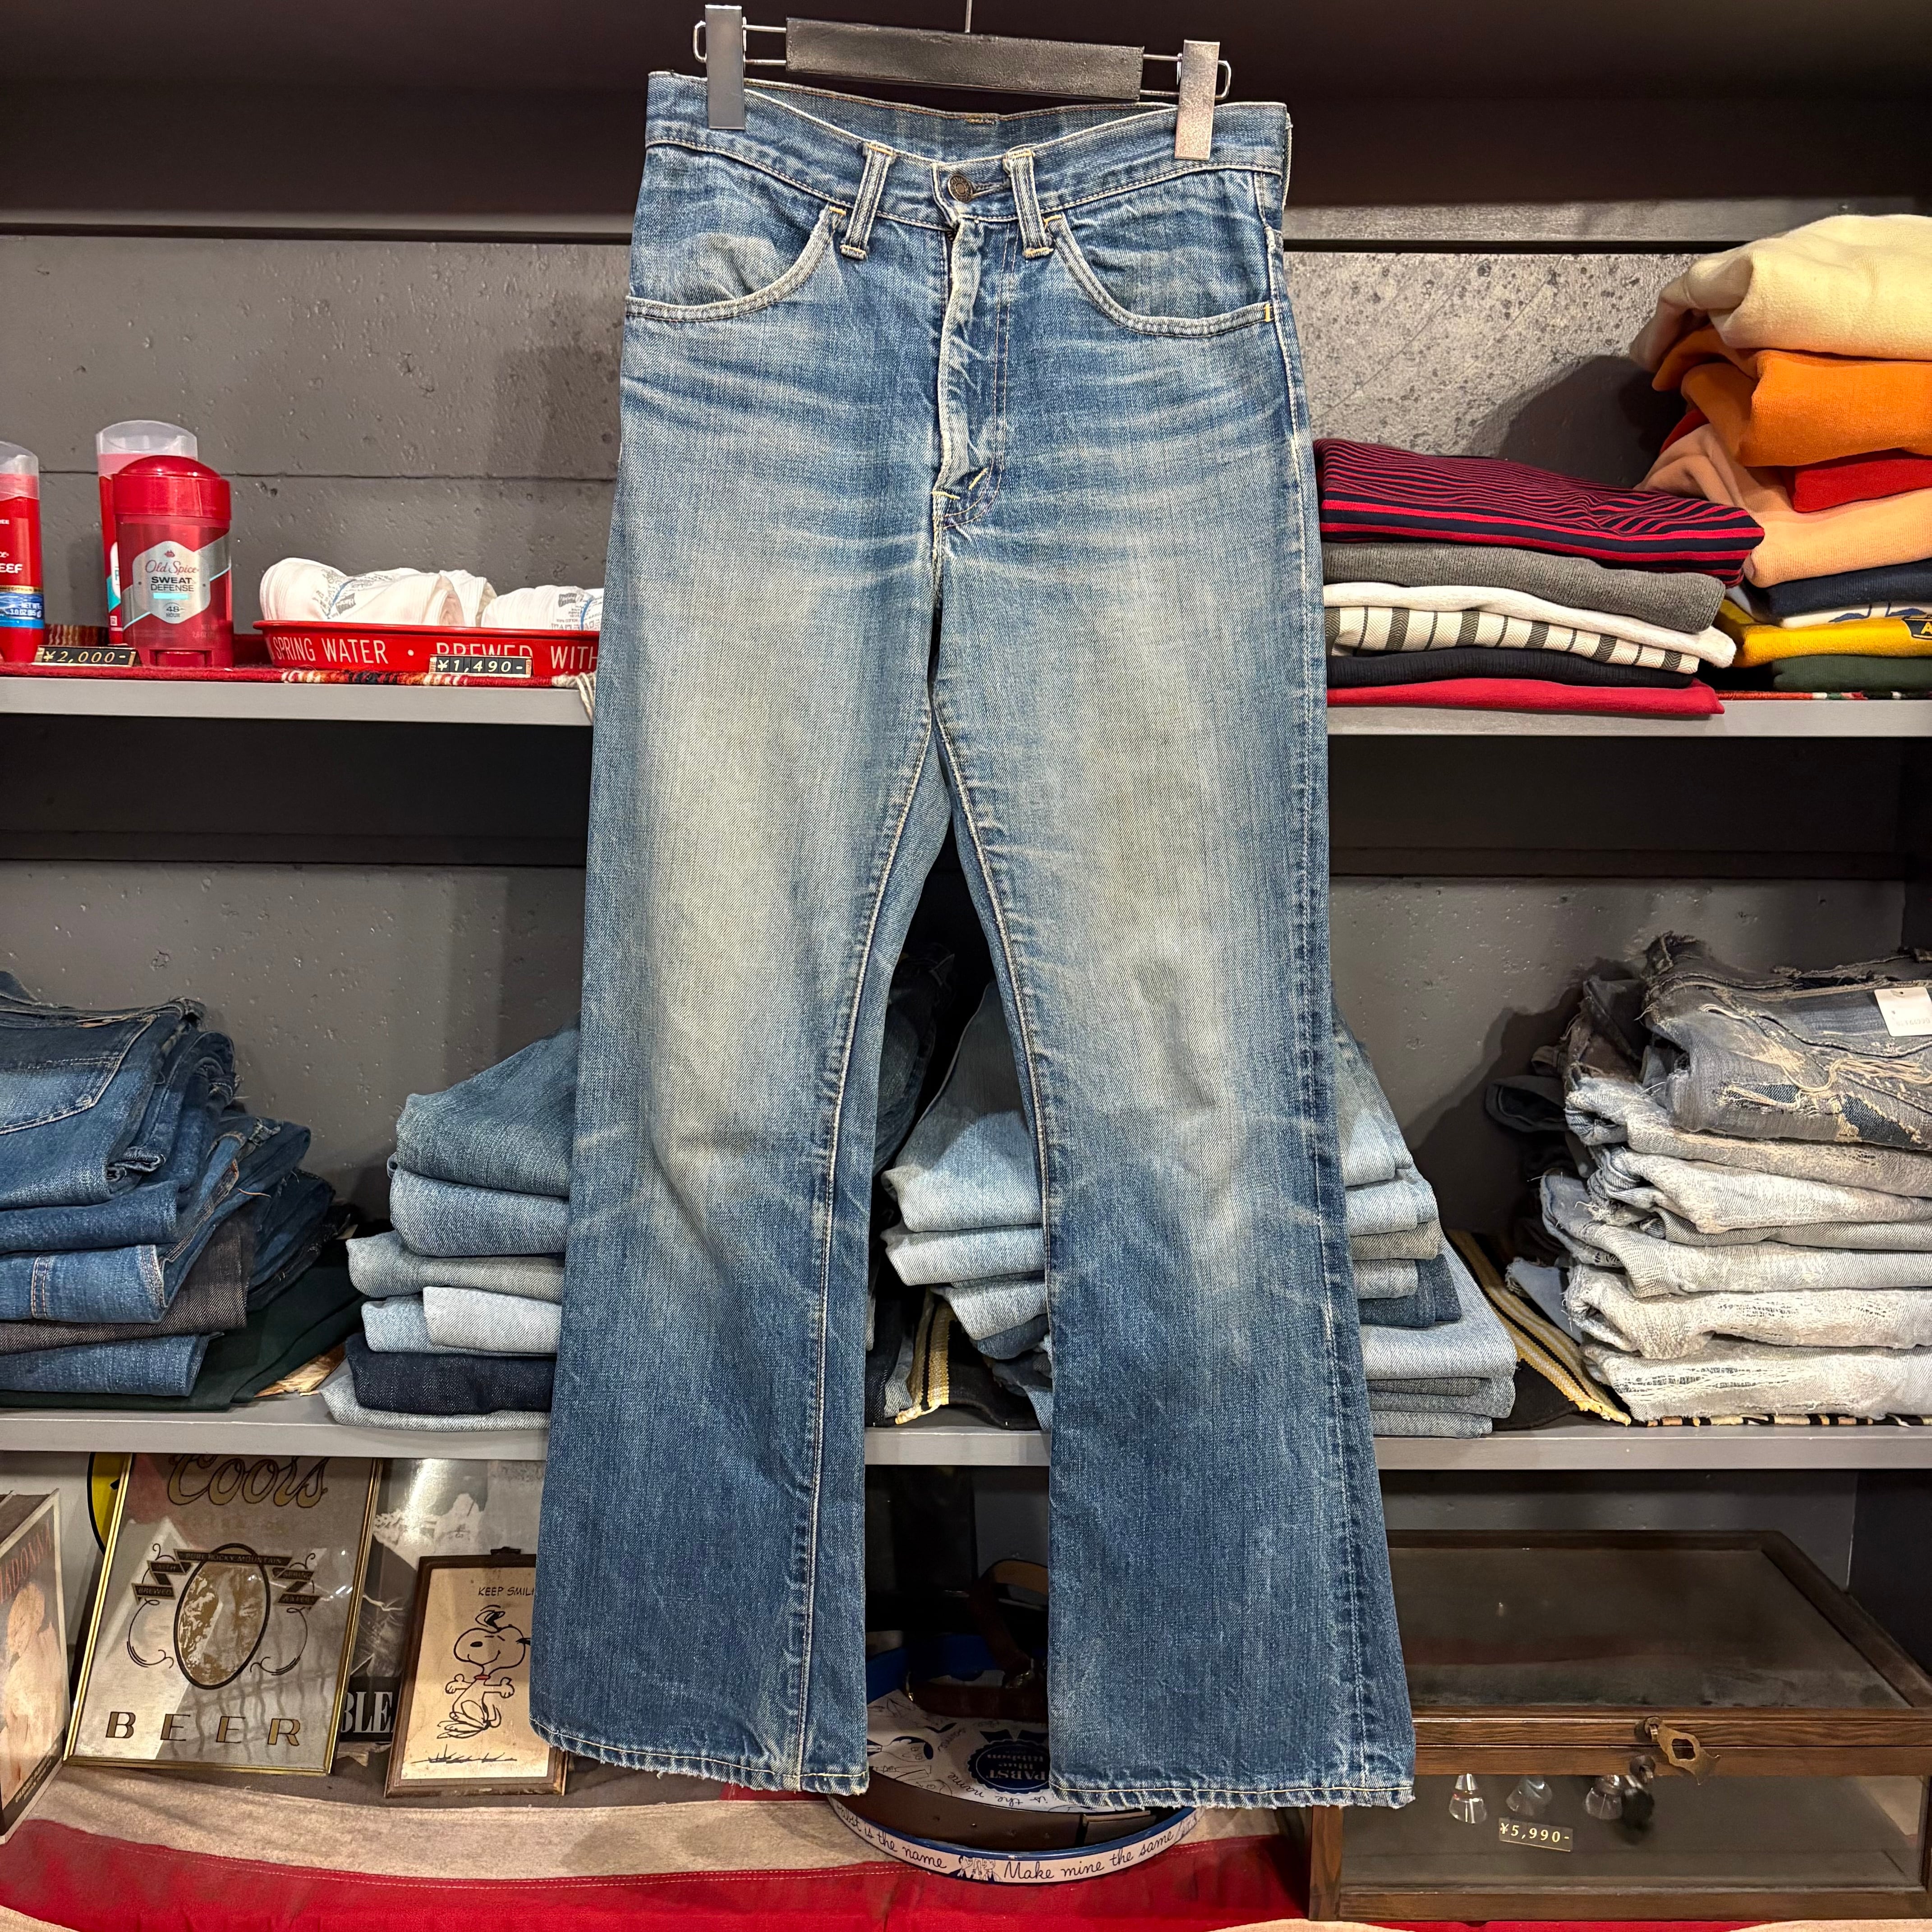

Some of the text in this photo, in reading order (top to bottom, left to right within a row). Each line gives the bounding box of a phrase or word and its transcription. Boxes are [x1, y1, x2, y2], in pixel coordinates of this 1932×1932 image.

[145, 560, 199, 575] Old Spice
[272, 636, 316, 662] SPRING
[321, 638, 389, 664] WATER
[167, 1454, 329, 1509] Coors
[478, 1587, 504, 1596] KEEP
[106, 1711, 300, 1746] BEER
[948, 1772, 984, 1798] name
[986, 1770, 1046, 1780] PABST
[995, 1795, 1023, 1807] the
[1500, 1822, 1569, 1843] ¥5,990-
[865, 1826, 875, 1839] is
[877, 1831, 898, 1852] the
[902, 1847, 947, 1868] name
[1003, 1831, 1174, 1880] Make mine the same
